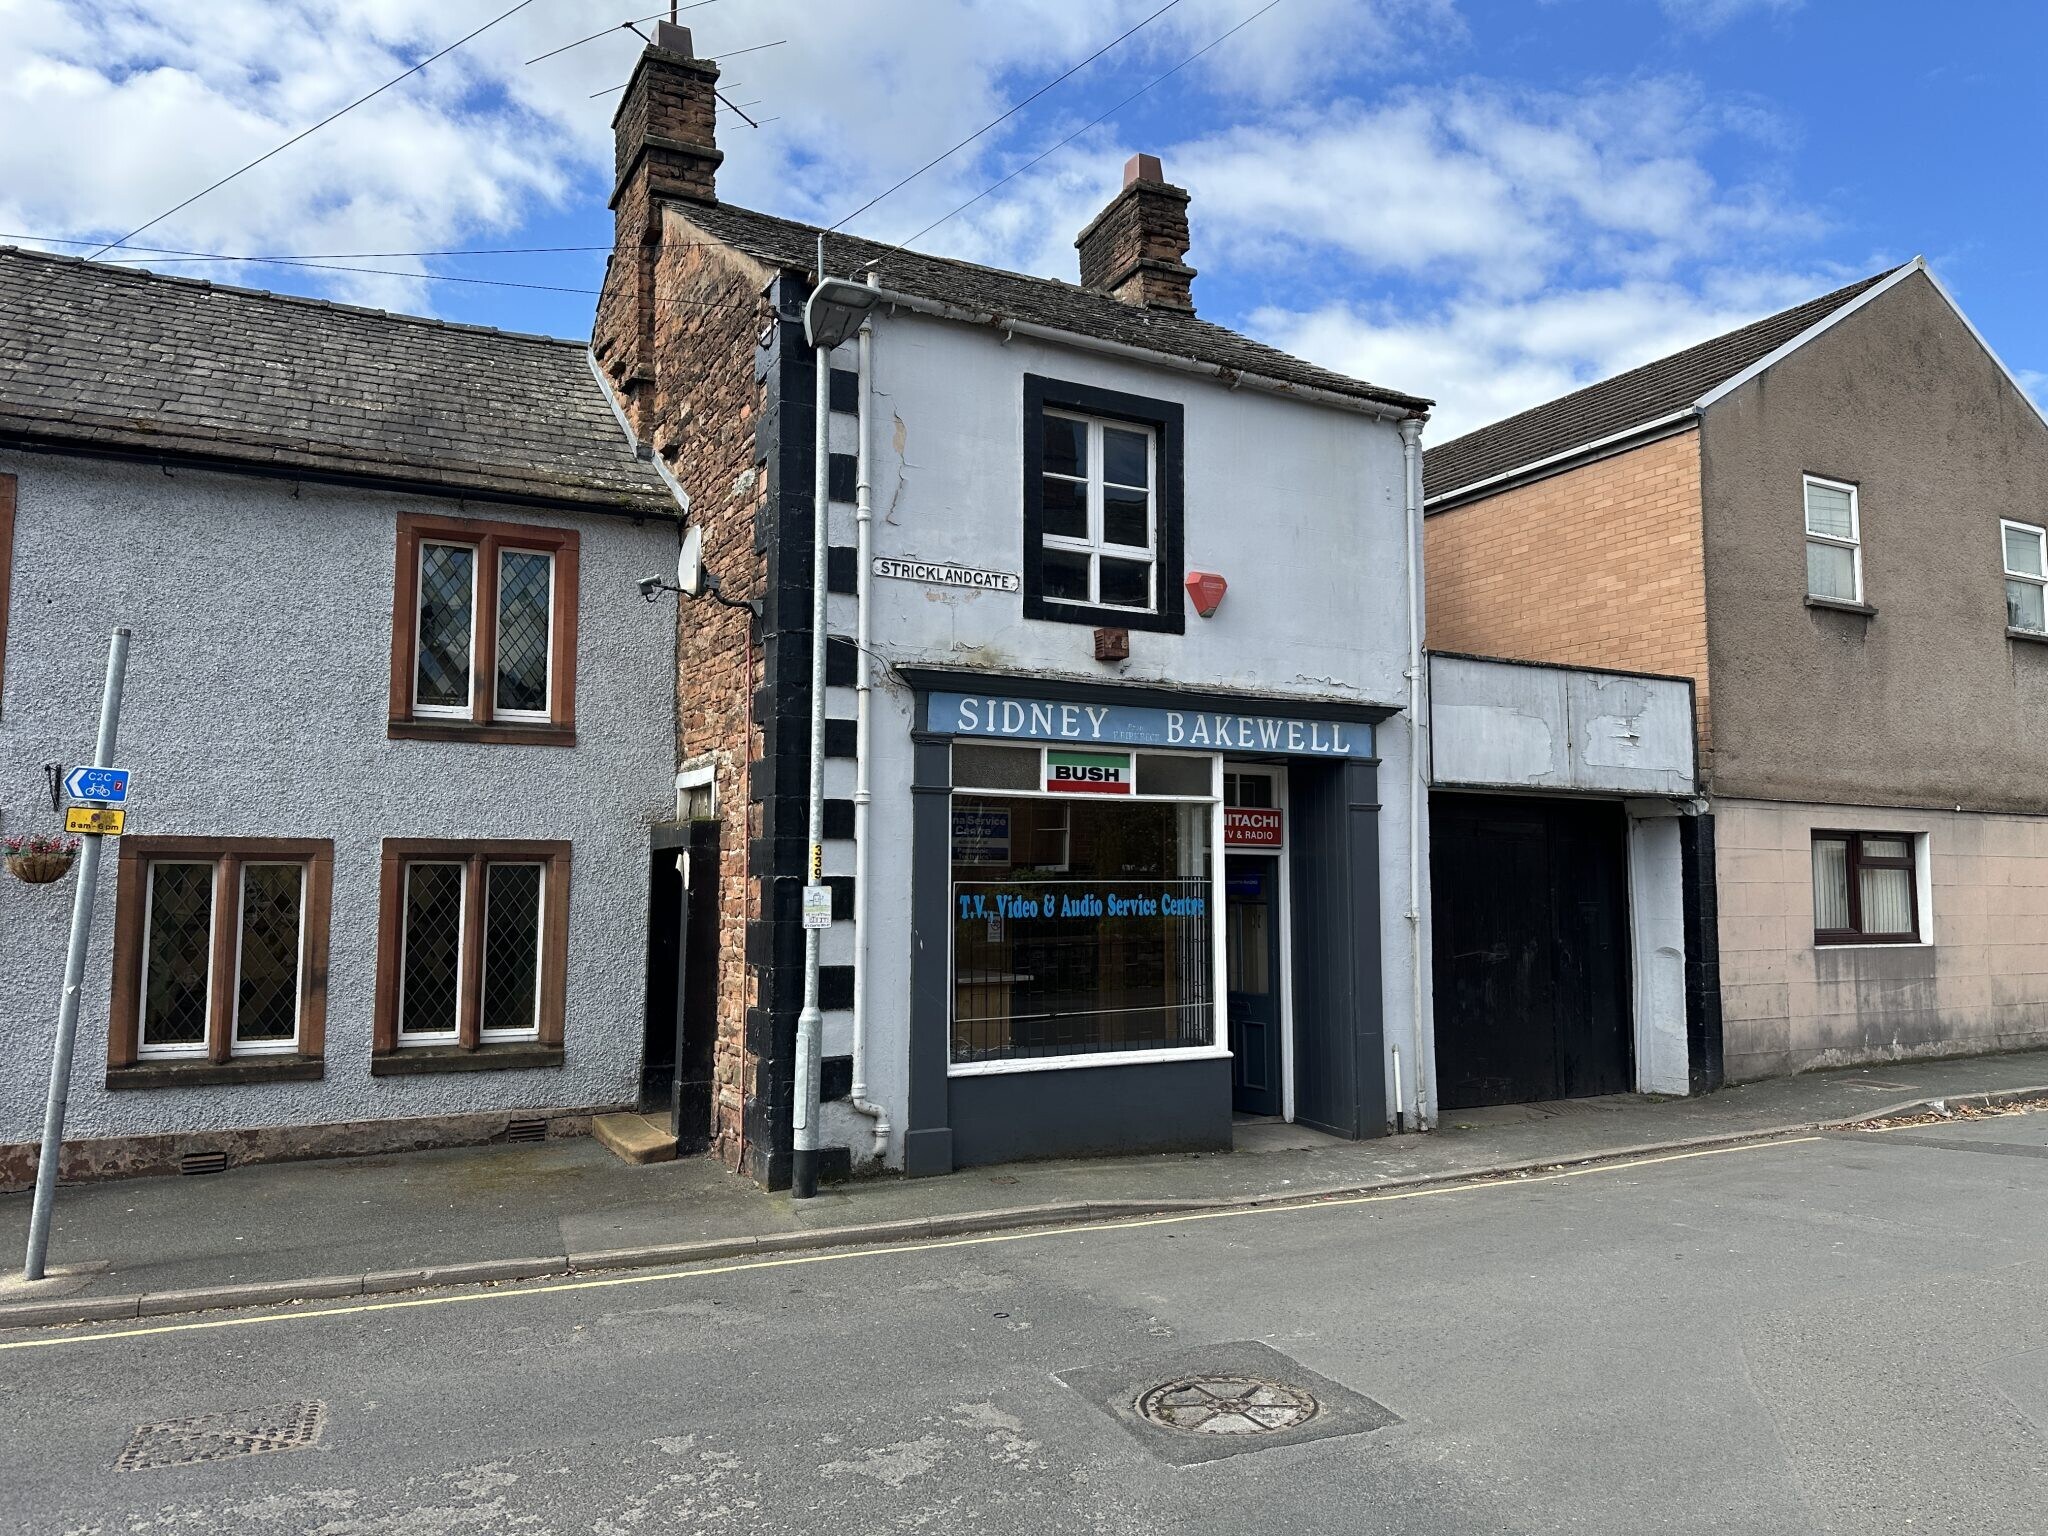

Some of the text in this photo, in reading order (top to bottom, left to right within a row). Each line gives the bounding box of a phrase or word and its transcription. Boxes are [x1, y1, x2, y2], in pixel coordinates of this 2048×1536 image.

[880, 561, 1010, 589] STRICKLANDGATE
[957, 698, 1350, 753] SIDNEY BAKEWELL
[88, 772, 112, 782] C2C
[1055, 765, 1120, 782] BUSH
[116, 782, 122, 790] 7
[70, 821, 77, 829] 8
[967, 815, 1007, 827] Service
[1236, 830, 1243, 839] &
[1245, 831, 1274, 840] RADIO
[996, 894, 1039, 919] Video
[1043, 893, 1056, 918] &
[1060, 893, 1103, 918] Audio
[1107, 893, 1157, 917] Service
[1161, 893, 1205, 917] Centre
